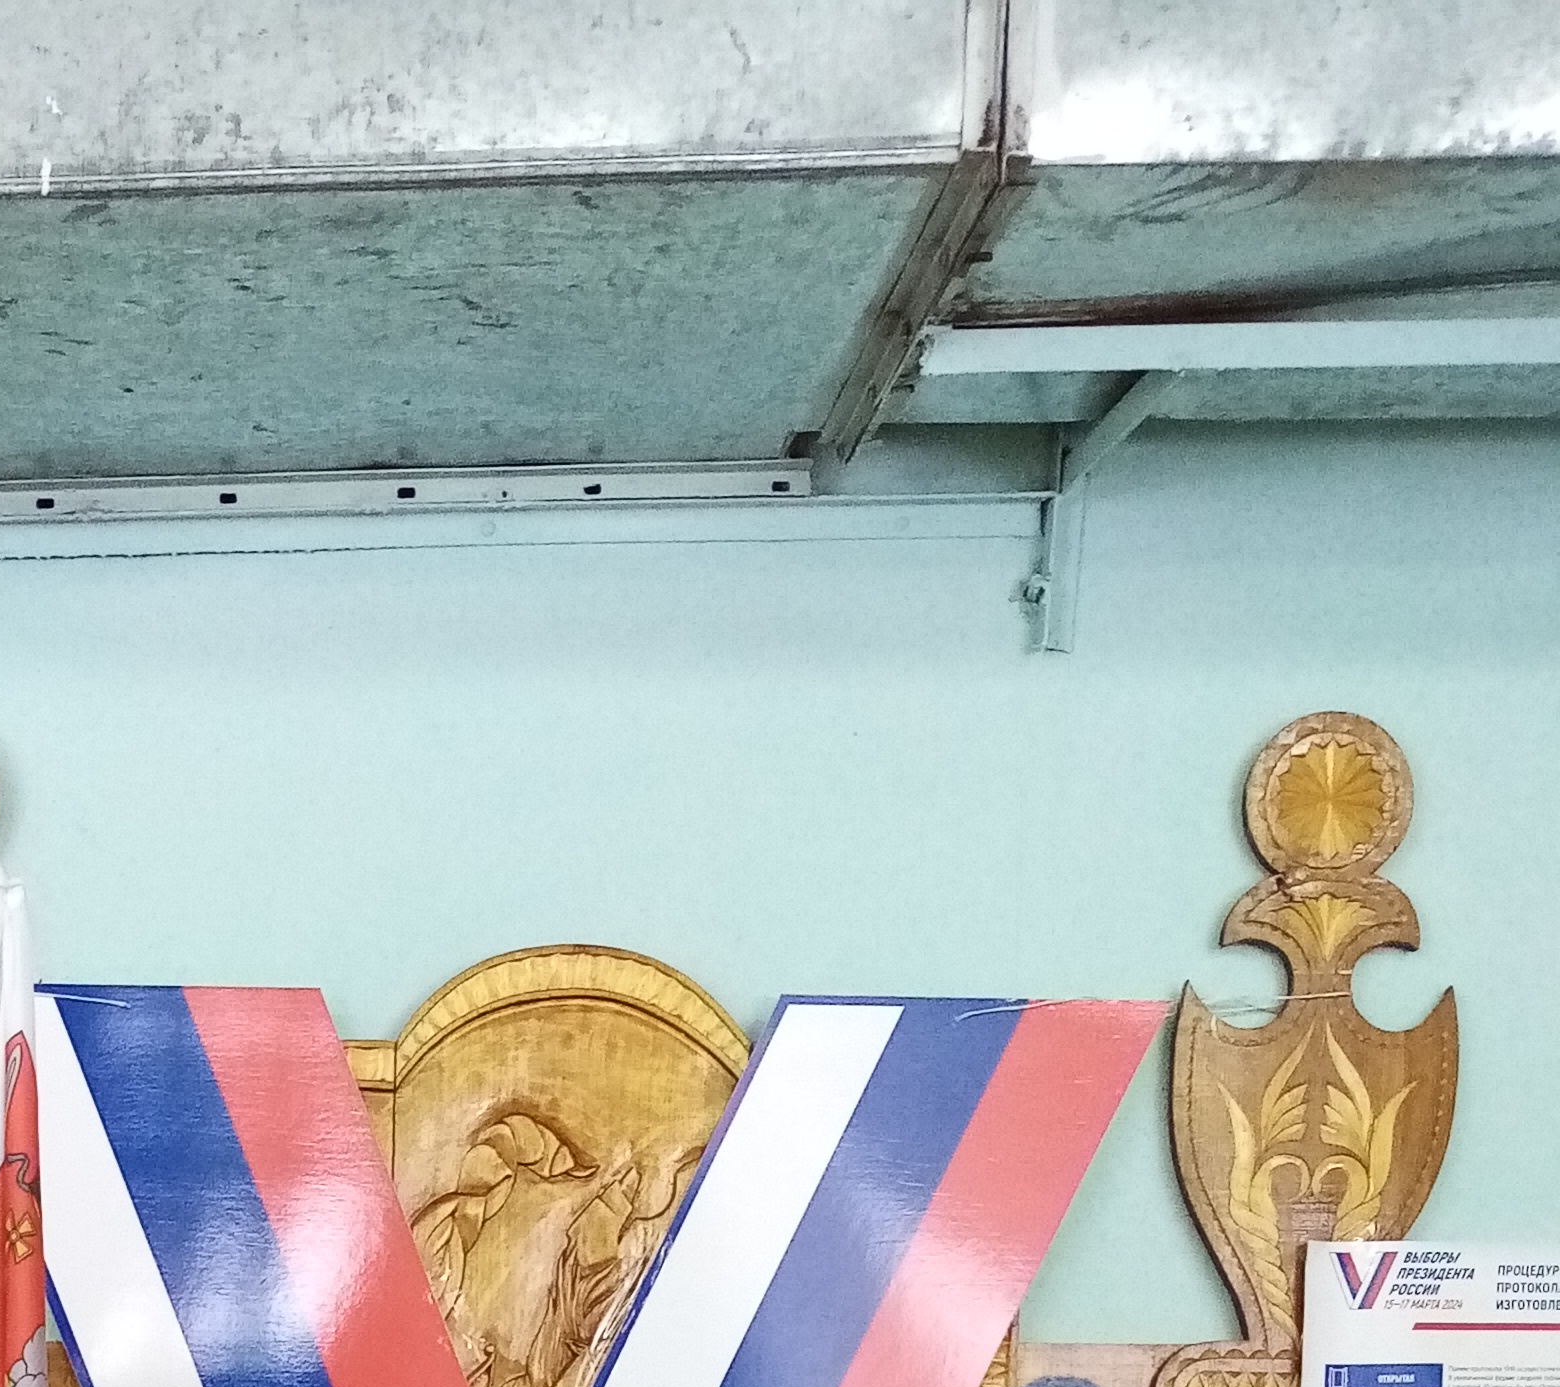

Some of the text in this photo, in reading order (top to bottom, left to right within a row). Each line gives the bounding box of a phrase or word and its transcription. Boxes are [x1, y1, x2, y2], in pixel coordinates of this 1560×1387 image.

[1403, 1251, 1461, 1264] ВЫБОРЫ
[1396, 1267, 1475, 1281] ПРЕЗИДЕНТА
[1389, 1284, 1441, 1296] РОССИИ
[1496, 1282, 1560, 1293] ПРОТОКОЛ
[1410, 1299, 1441, 1310] МАРТА
[1441, 1299, 1464, 1310] 2024
